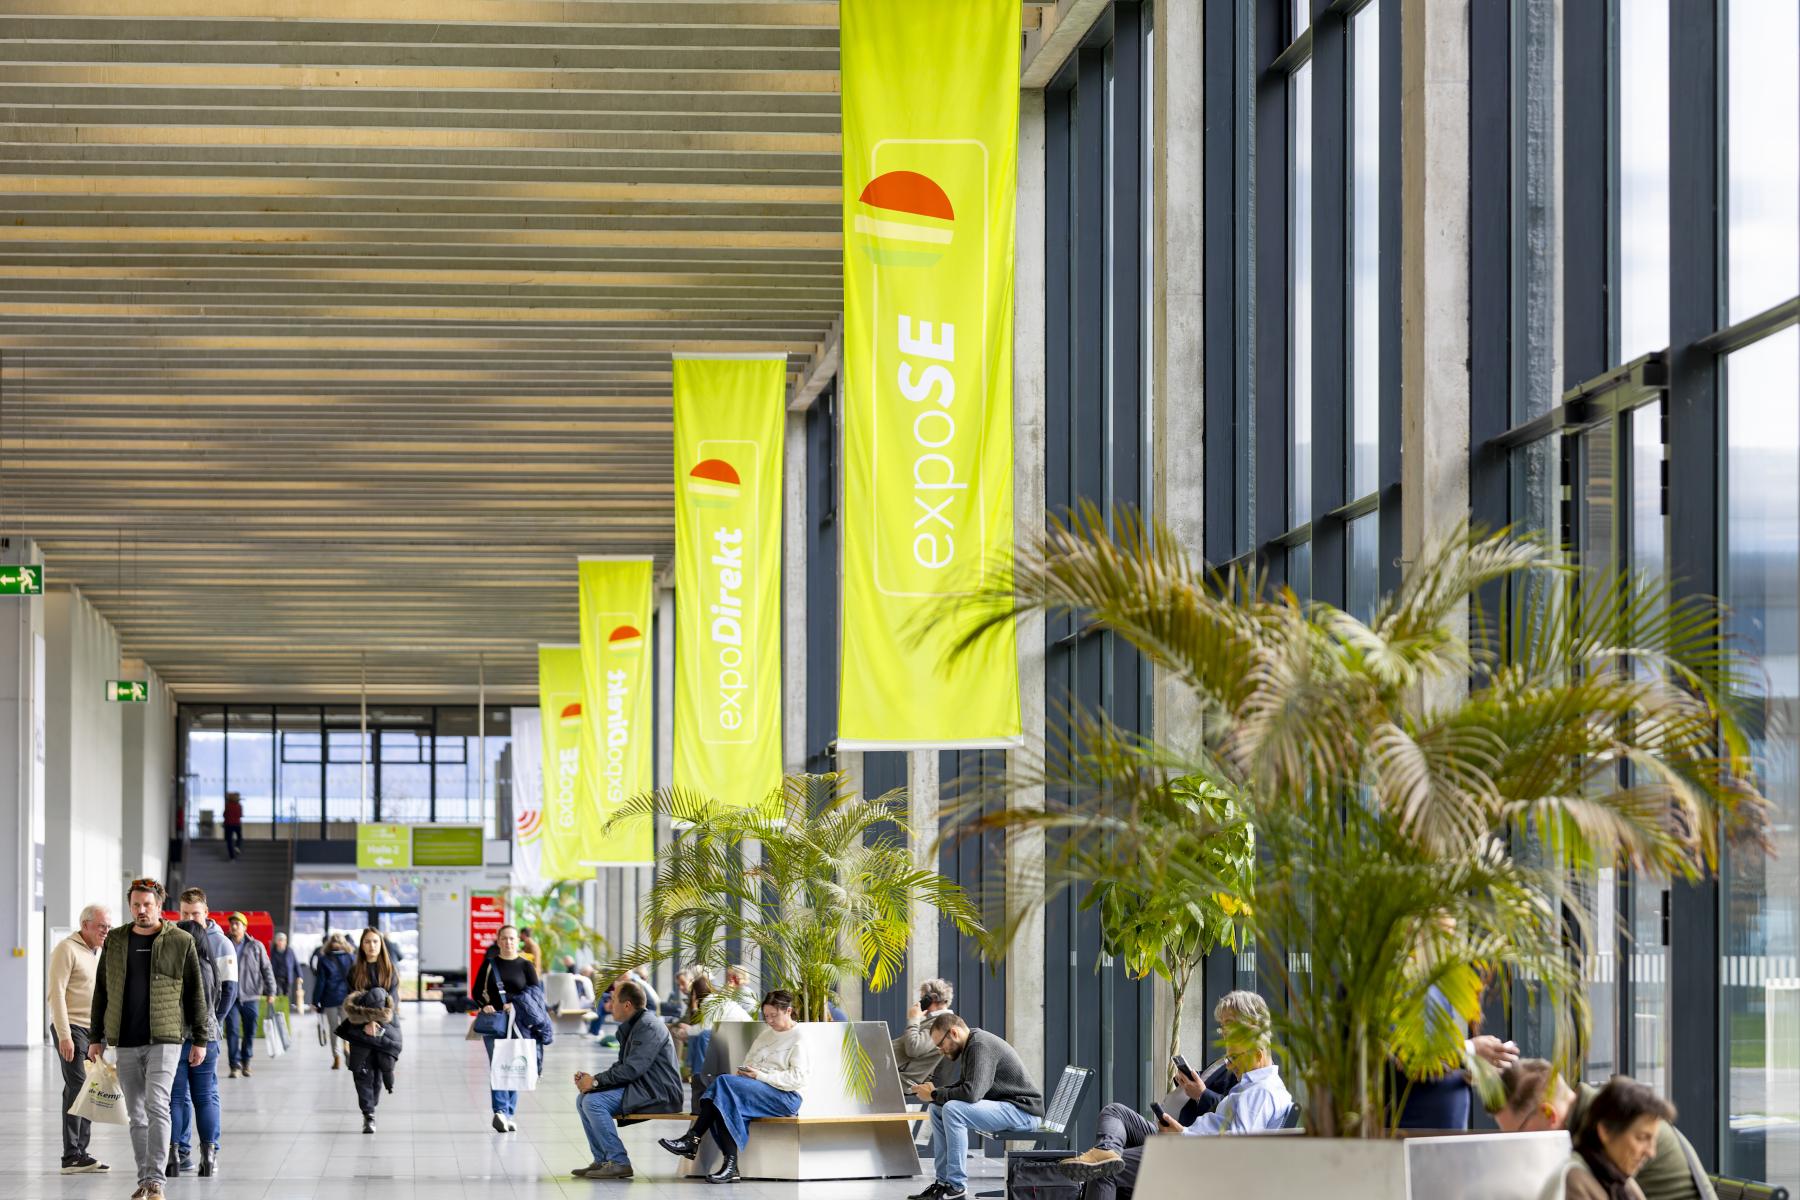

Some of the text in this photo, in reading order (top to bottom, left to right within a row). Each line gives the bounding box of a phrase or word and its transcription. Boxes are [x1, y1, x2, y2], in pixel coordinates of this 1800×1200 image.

[897, 314, 967, 569] expoSE
[711, 526, 748, 731] expoDirekt
[97, 1090, 121, 1101] Kemp
